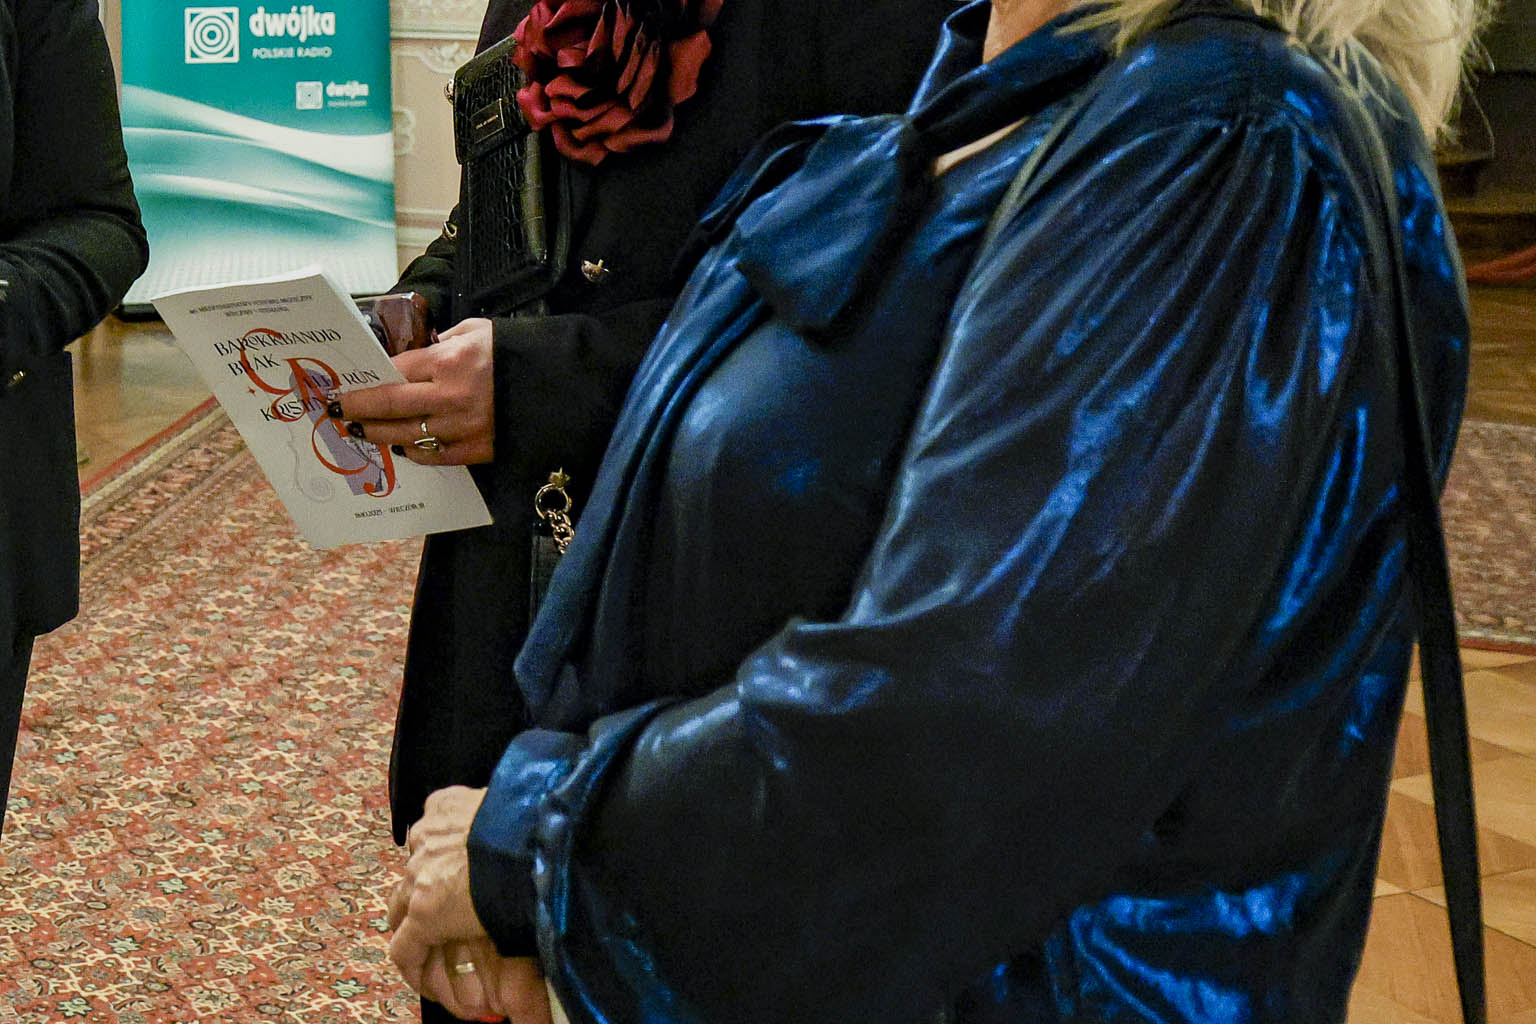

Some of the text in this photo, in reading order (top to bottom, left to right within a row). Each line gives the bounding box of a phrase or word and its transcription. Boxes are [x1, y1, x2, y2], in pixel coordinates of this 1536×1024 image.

[249, 5, 336, 42] dwójka
[253, 47, 332, 59] POLSKIE RADIO
